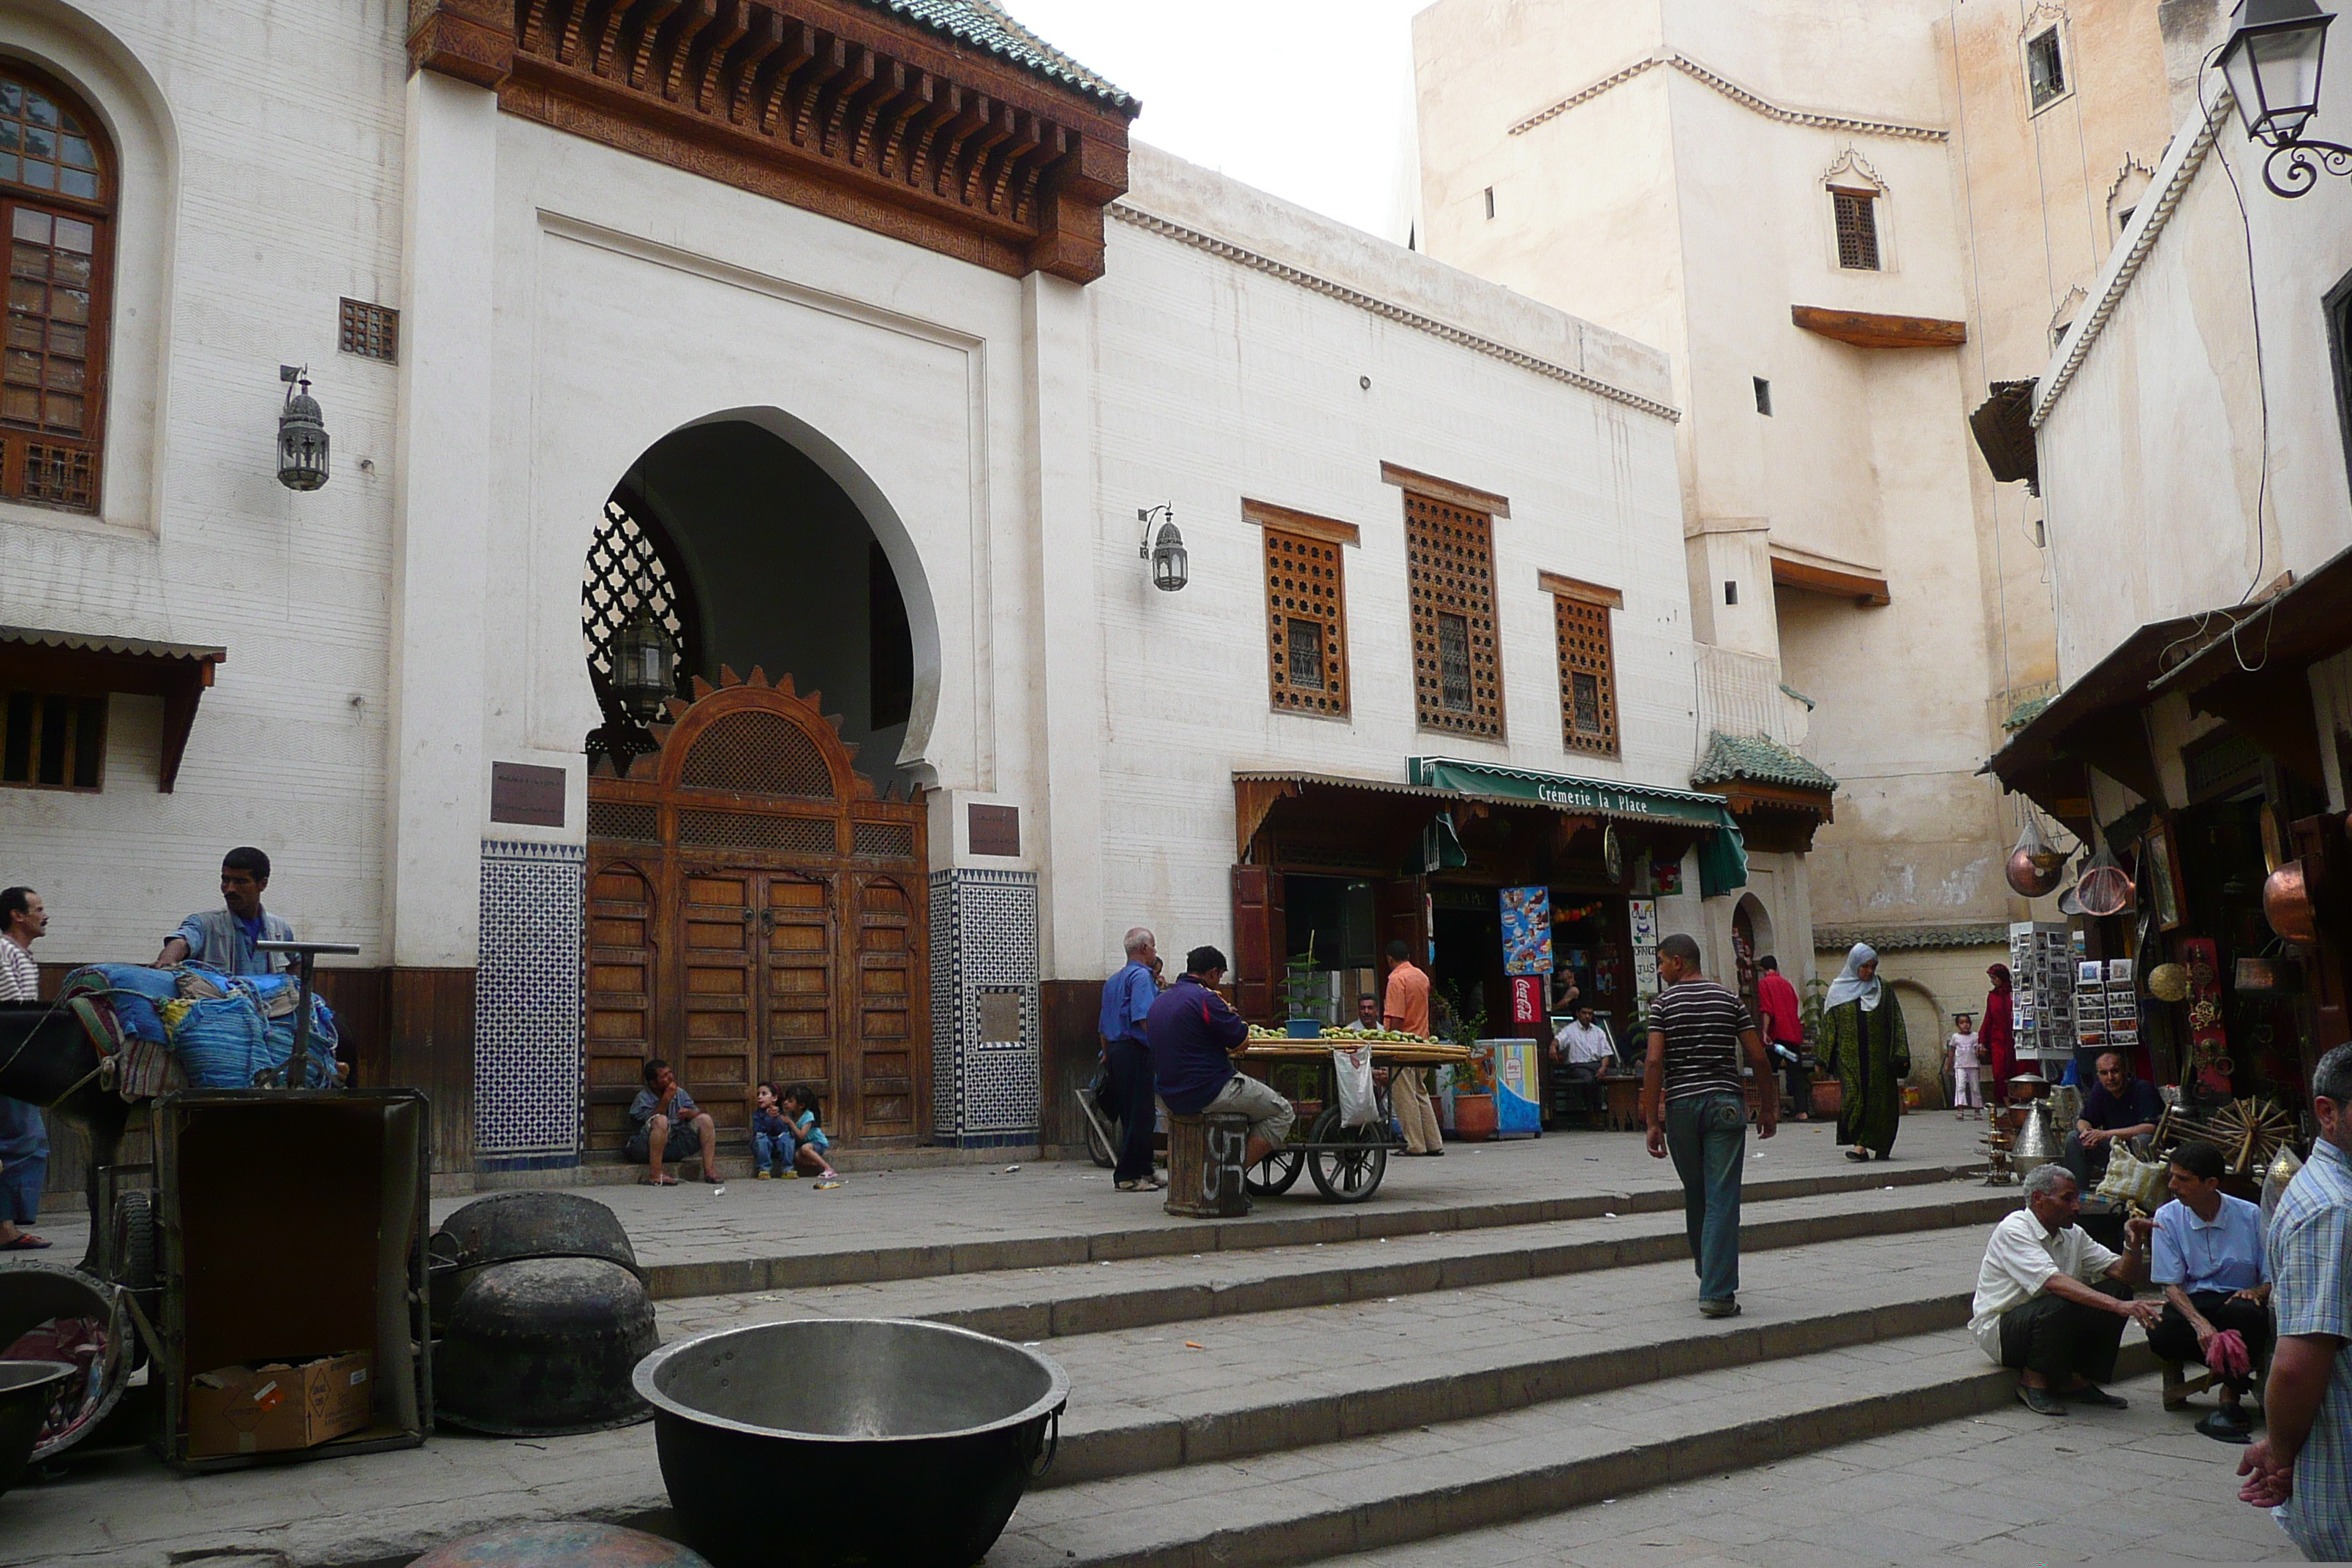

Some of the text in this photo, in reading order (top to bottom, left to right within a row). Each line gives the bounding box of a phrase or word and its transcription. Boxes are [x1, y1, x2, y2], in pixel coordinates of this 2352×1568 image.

[1538, 784, 1648, 813] Crémerie la Place
[1637, 963, 1655, 975] JUS
